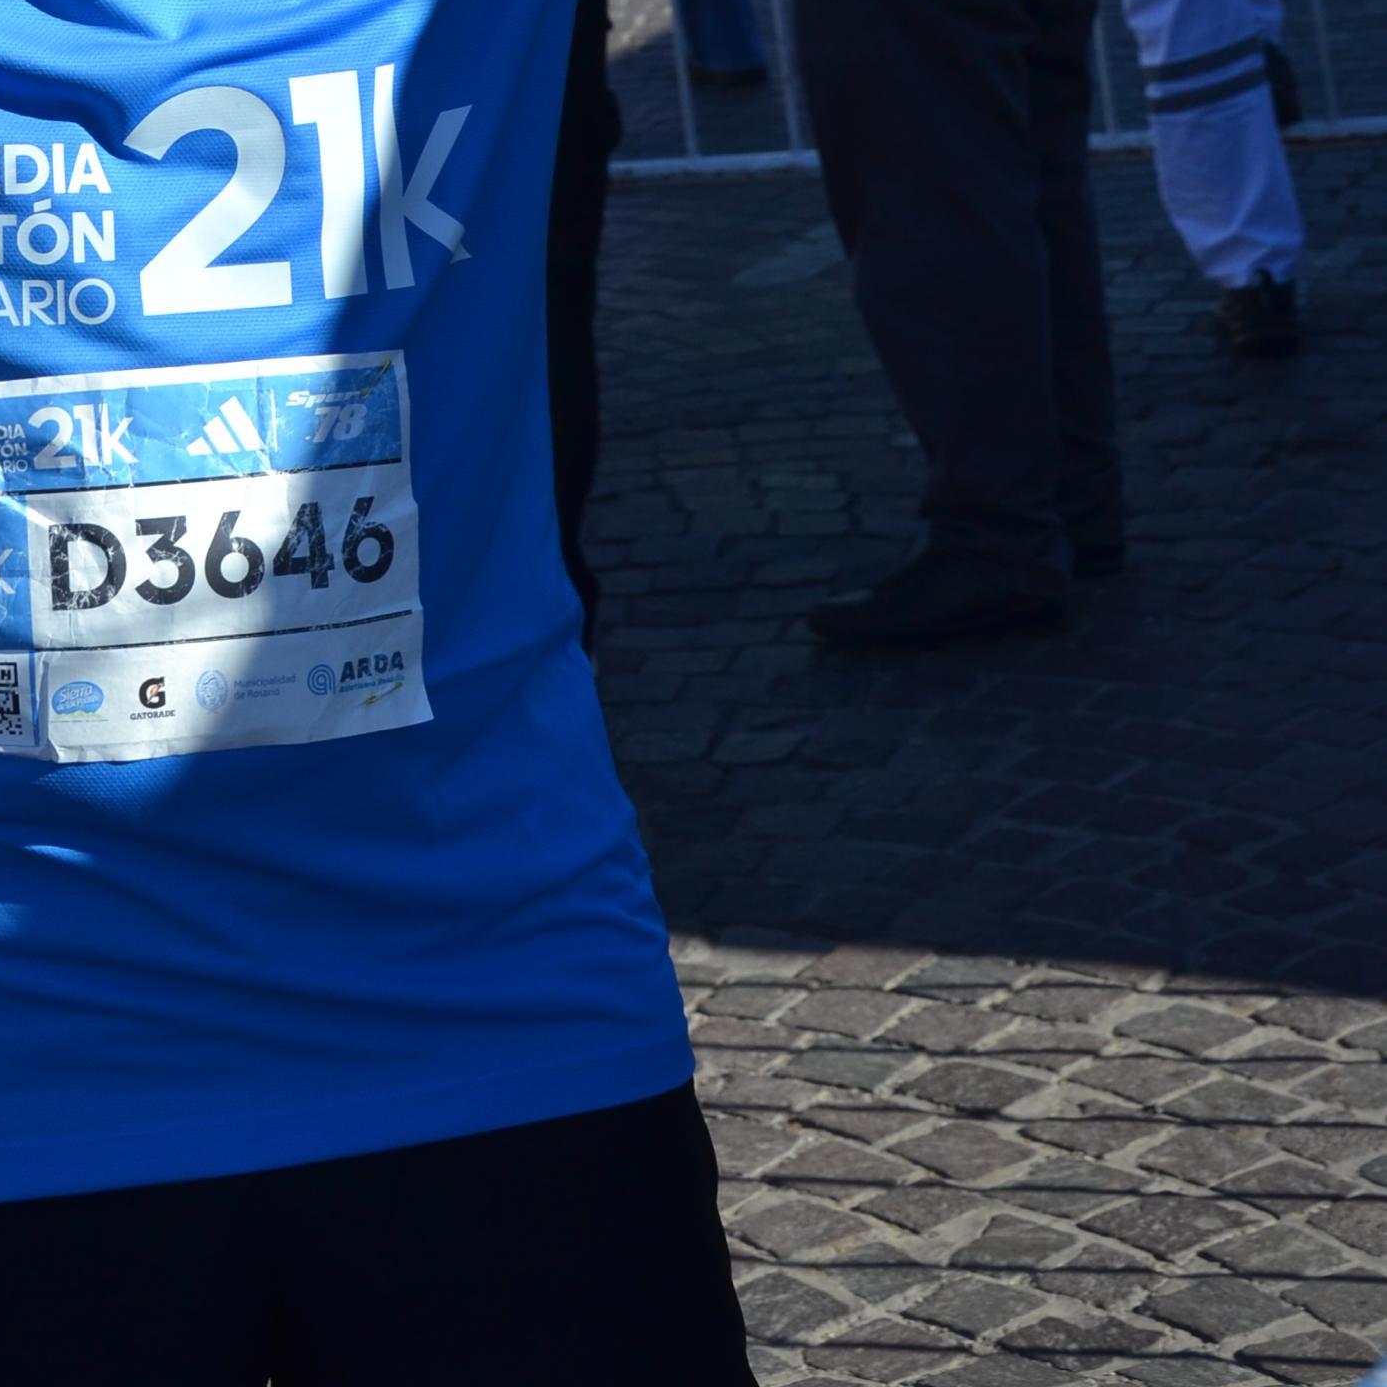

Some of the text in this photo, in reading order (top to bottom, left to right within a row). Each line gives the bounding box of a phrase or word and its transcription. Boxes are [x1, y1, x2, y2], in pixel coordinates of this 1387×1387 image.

[313, 403, 367, 444] 78
[49, 497, 395, 612] D3646
[340, 651, 404, 684] ARDA
[234, 674, 296, 690] Municipalidad
[234, 687, 280, 700] de Rosario
[130, 709, 176, 721] GATORADE
